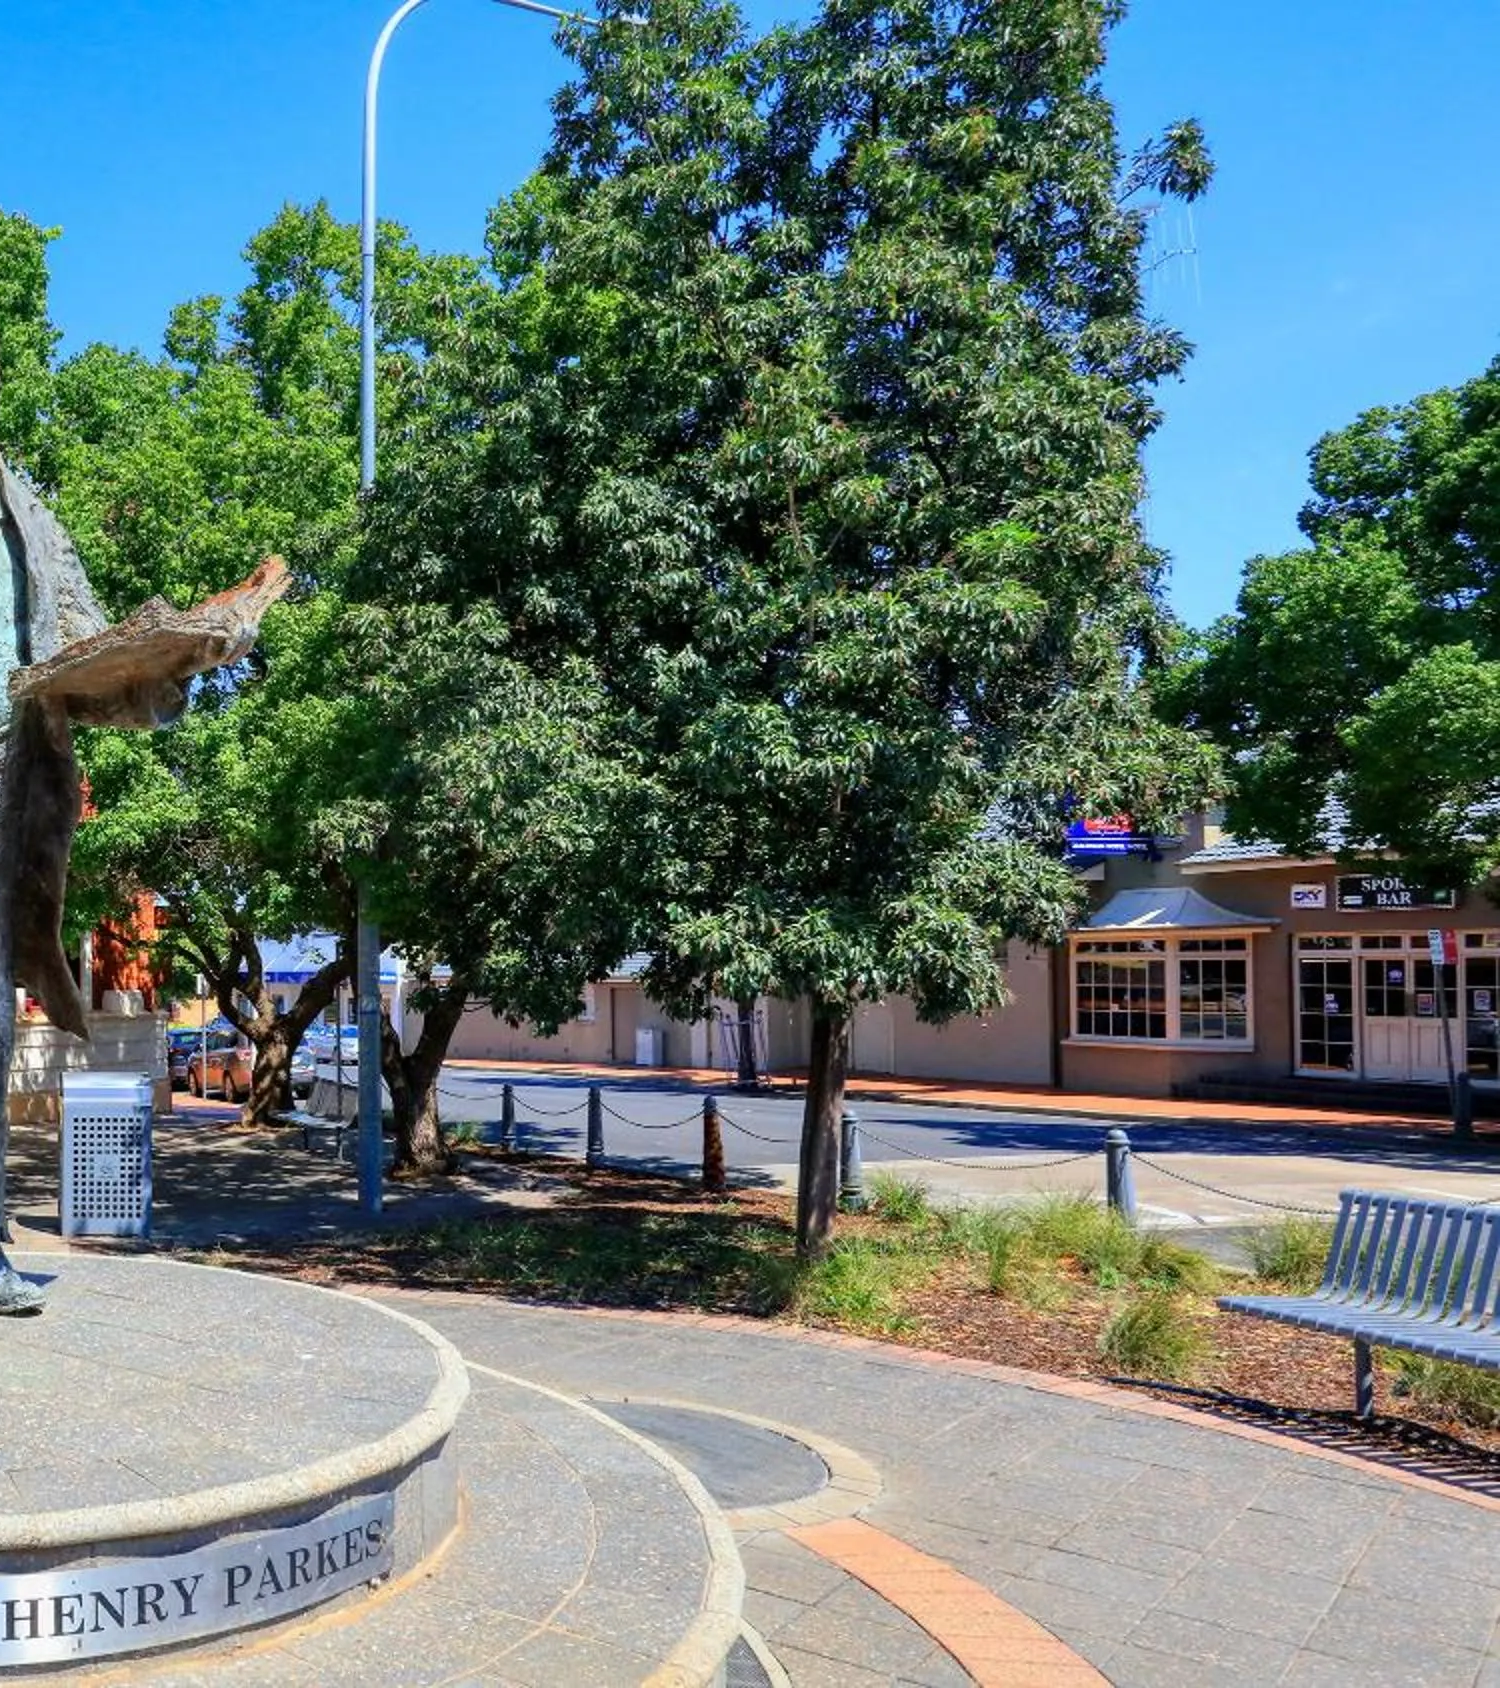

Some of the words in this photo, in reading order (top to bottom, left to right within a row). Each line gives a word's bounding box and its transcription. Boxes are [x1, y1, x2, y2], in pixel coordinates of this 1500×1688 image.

[1377, 892, 1412, 905] BAR
[1, 1573, 204, 1641] HENRY
[223, 1517, 386, 1609] PARKES
